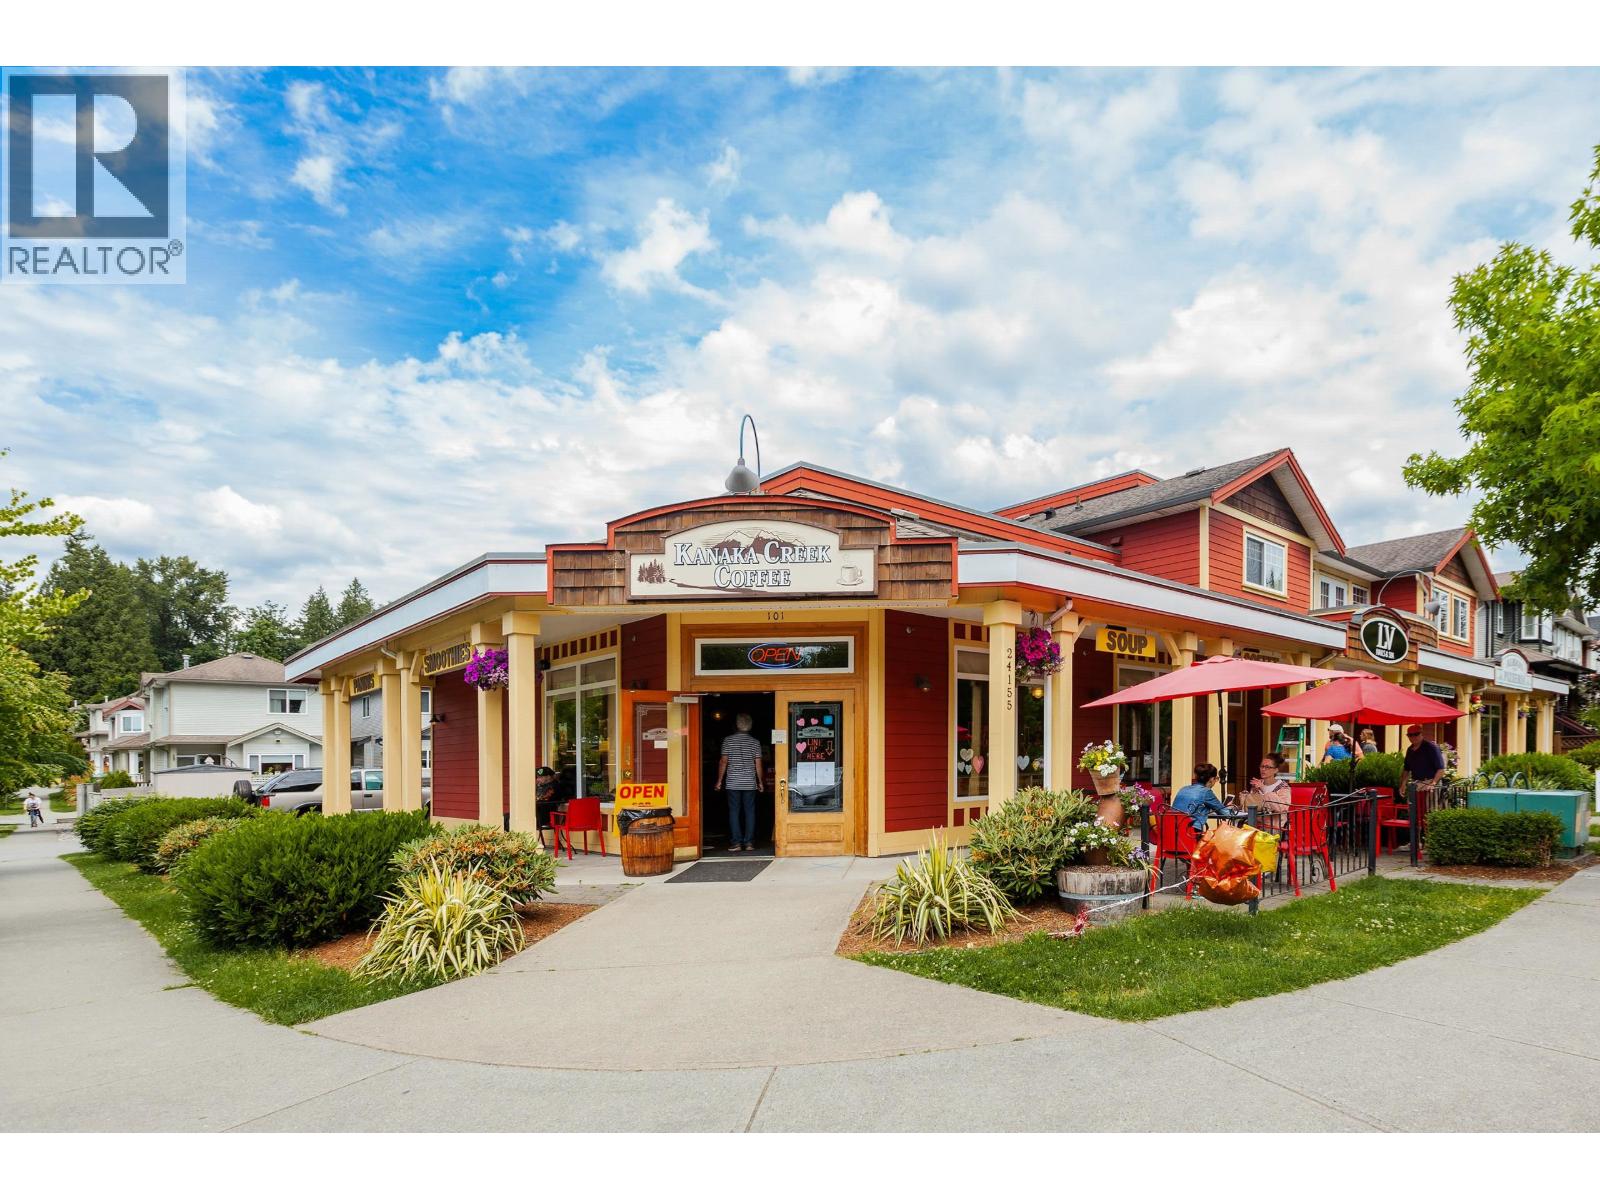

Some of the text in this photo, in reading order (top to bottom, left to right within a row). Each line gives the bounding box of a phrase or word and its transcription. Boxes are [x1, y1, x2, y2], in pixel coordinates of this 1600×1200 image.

[674, 540, 831, 566] KANAKA CREEK
[713, 564, 791, 588] COFFEE
[767, 611, 784, 621] 101
[1106, 630, 1148, 655] SOUP
[1376, 622, 1396, 651] LV
[423, 641, 471, 673] SMOOTHIES
[751, 647, 801, 662] OPEN
[619, 785, 665, 799] OPEN
